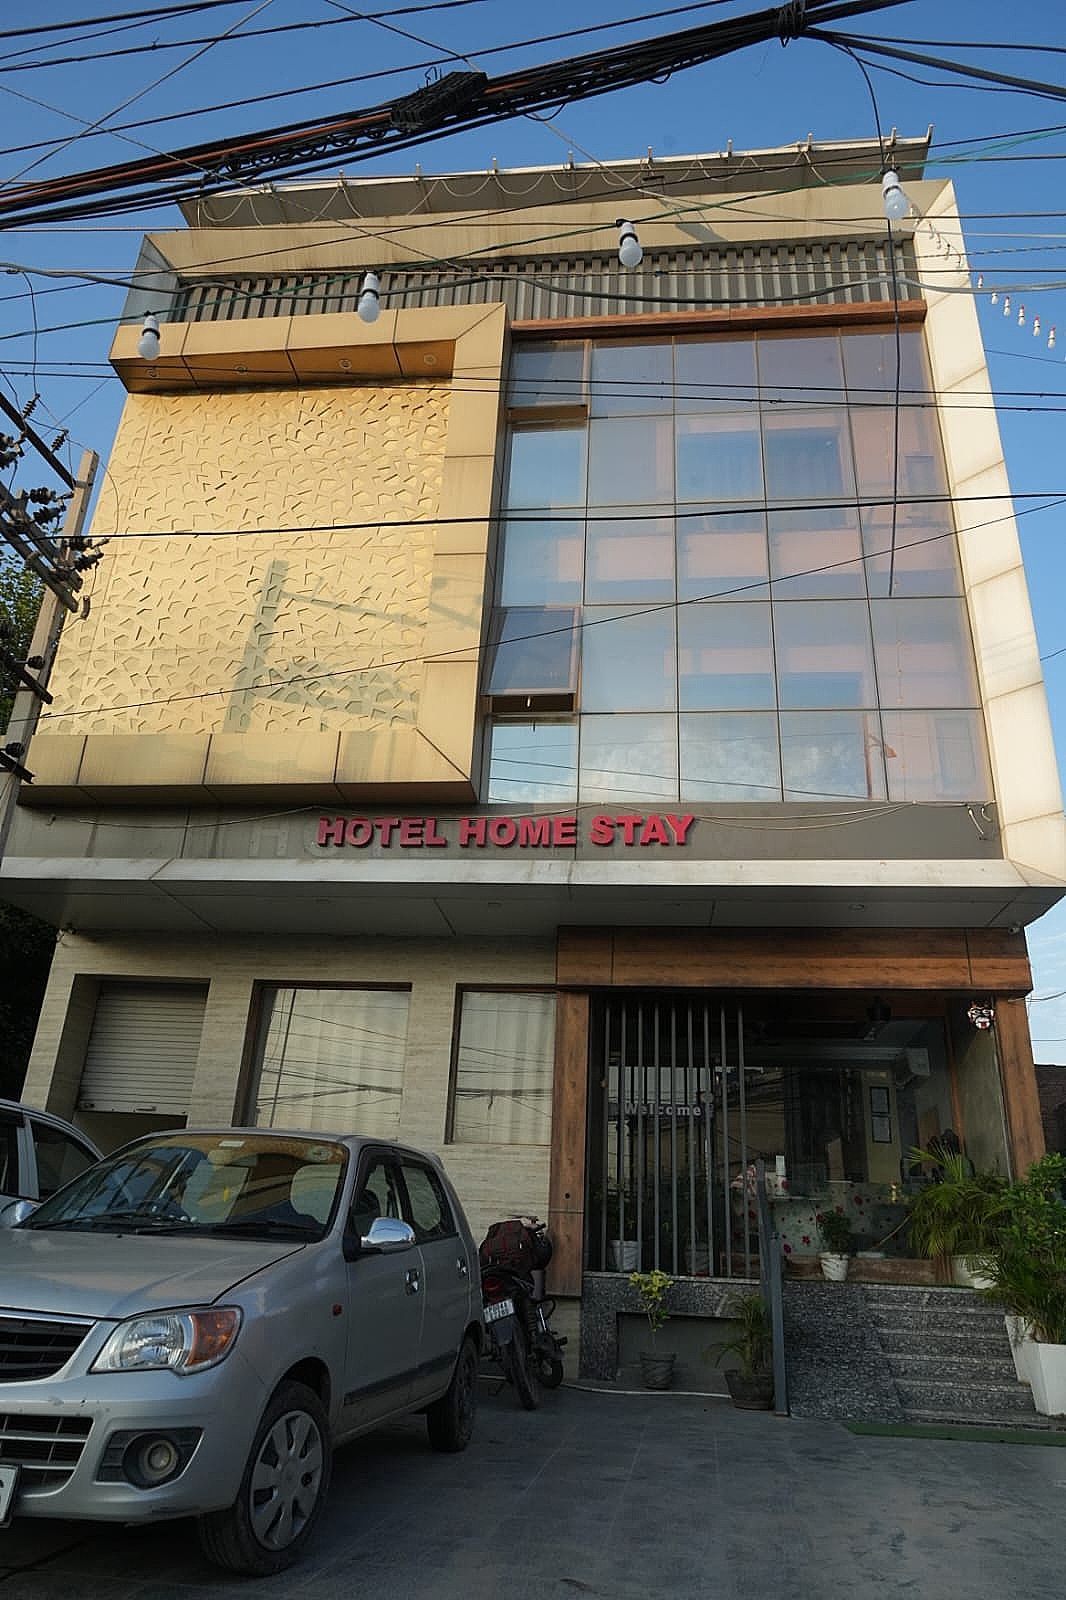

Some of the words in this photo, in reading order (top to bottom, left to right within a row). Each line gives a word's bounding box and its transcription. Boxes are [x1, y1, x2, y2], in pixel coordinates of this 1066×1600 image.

[318, 816, 447, 847] HOTEL
[459, 816, 577, 847] HOME
[590, 814, 695, 847] STAY
[624, 1103, 702, 1116] Welcome
